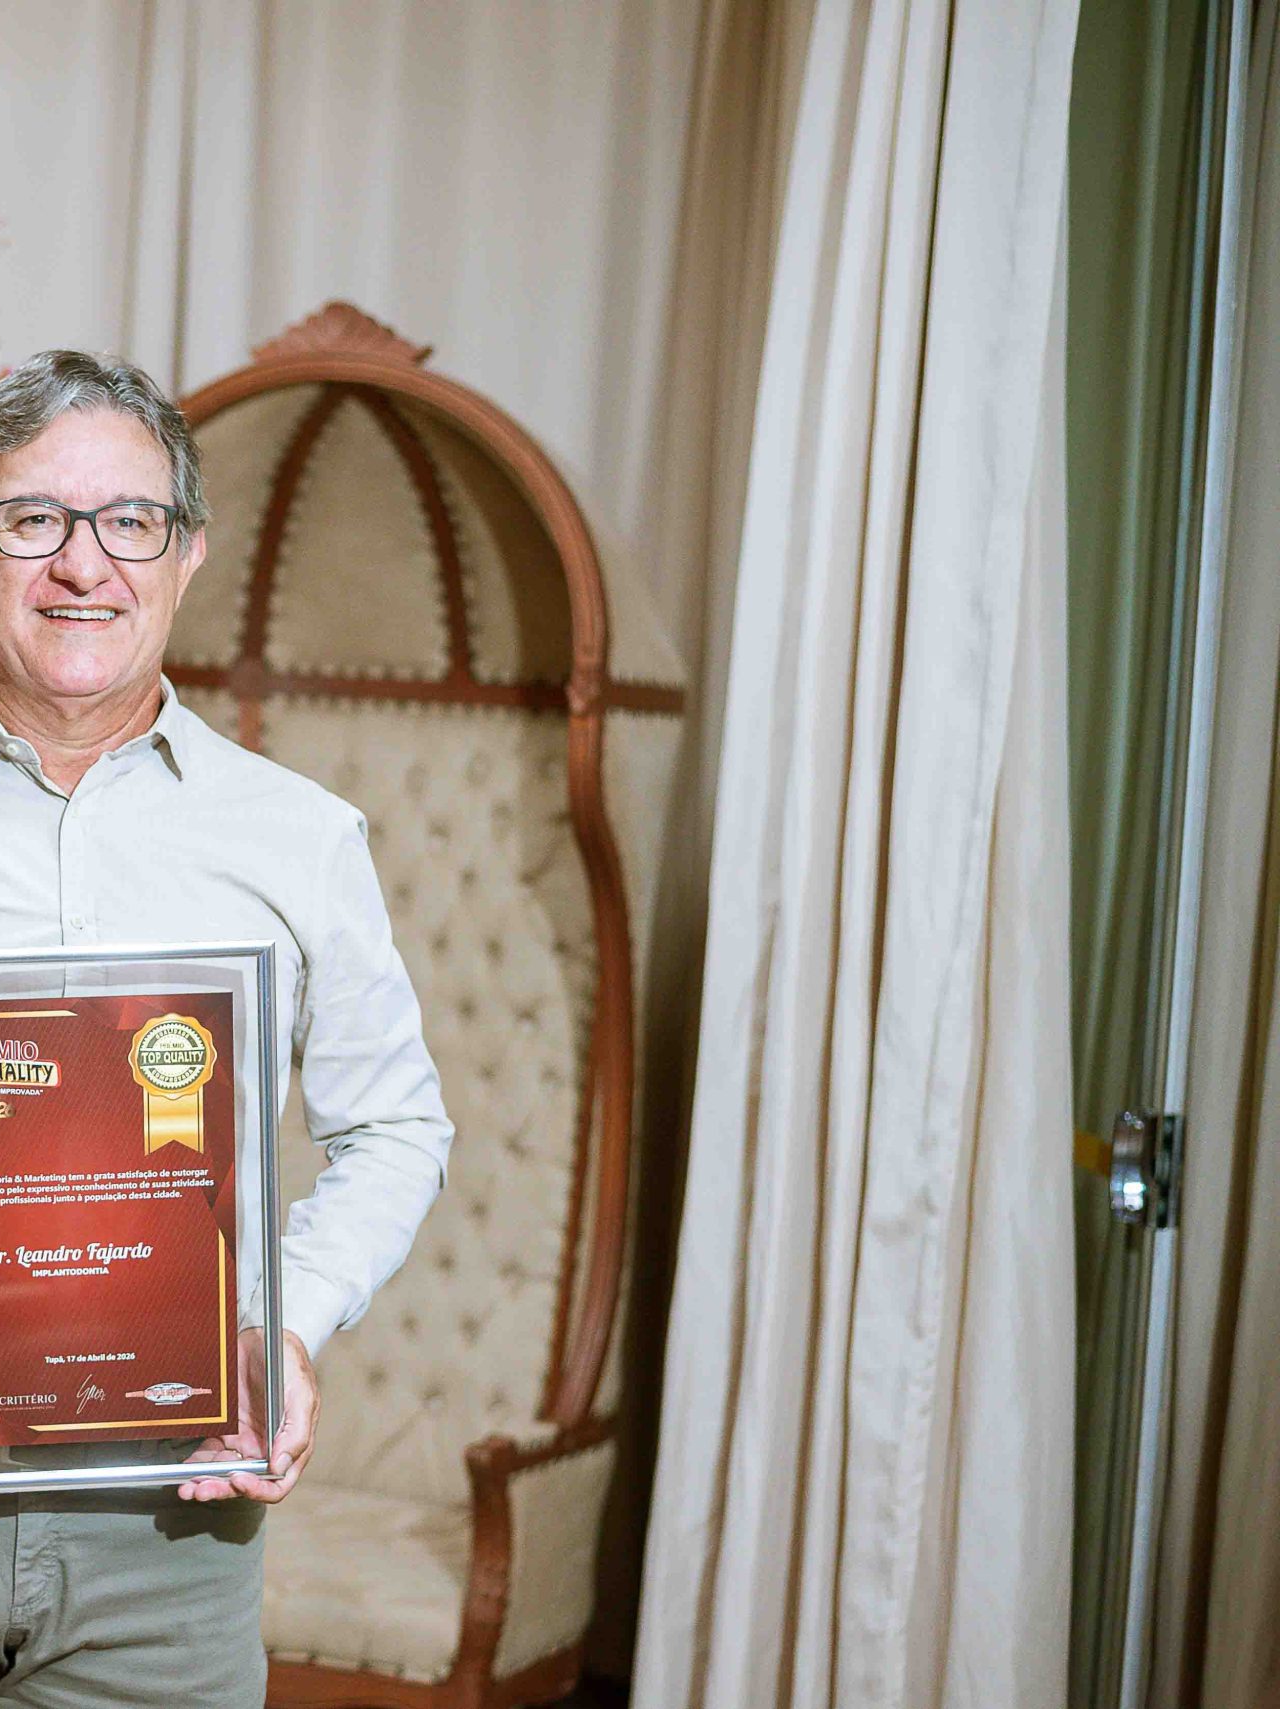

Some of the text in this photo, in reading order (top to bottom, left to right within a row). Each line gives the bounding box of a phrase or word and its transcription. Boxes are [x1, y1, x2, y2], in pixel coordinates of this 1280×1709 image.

[141, 1050, 204, 1064] TOP QUALITY
[14, 1174, 22, 1183] &
[23, 1172, 66, 1184] Marketing
[68, 1173, 84, 1181] tem
[93, 1172, 116, 1182] grata
[117, 1169, 158, 1180] satisfação
[159, 1169, 170, 1177] de
[171, 1168, 209, 1178] outorgar
[6, 1185, 25, 1195] pelo
[26, 1183, 70, 1195] expressivo
[71, 1181, 137, 1191] reconhecimento
[139, 1180, 150, 1189] de
[151, 1181, 170, 1189] suas
[171, 1178, 215, 1188] atividades
[0, 1194, 52, 1206] profissionais
[52, 1194, 76, 1205] junto
[84, 1192, 126, 1203] população
[128, 1191, 151, 1200] desta
[152, 1190, 183, 1199] cidade.
[15, 1245, 84, 1268] Leandro
[86, 1241, 154, 1265] Fajardo
[31, 1266, 110, 1278] IMPLANTODONTIA
[76, 1354, 86, 1362] de
[87, 1353, 106, 1362] Abril
[106, 1353, 116, 1361] de
[116, 1352, 136, 1361] 2026
